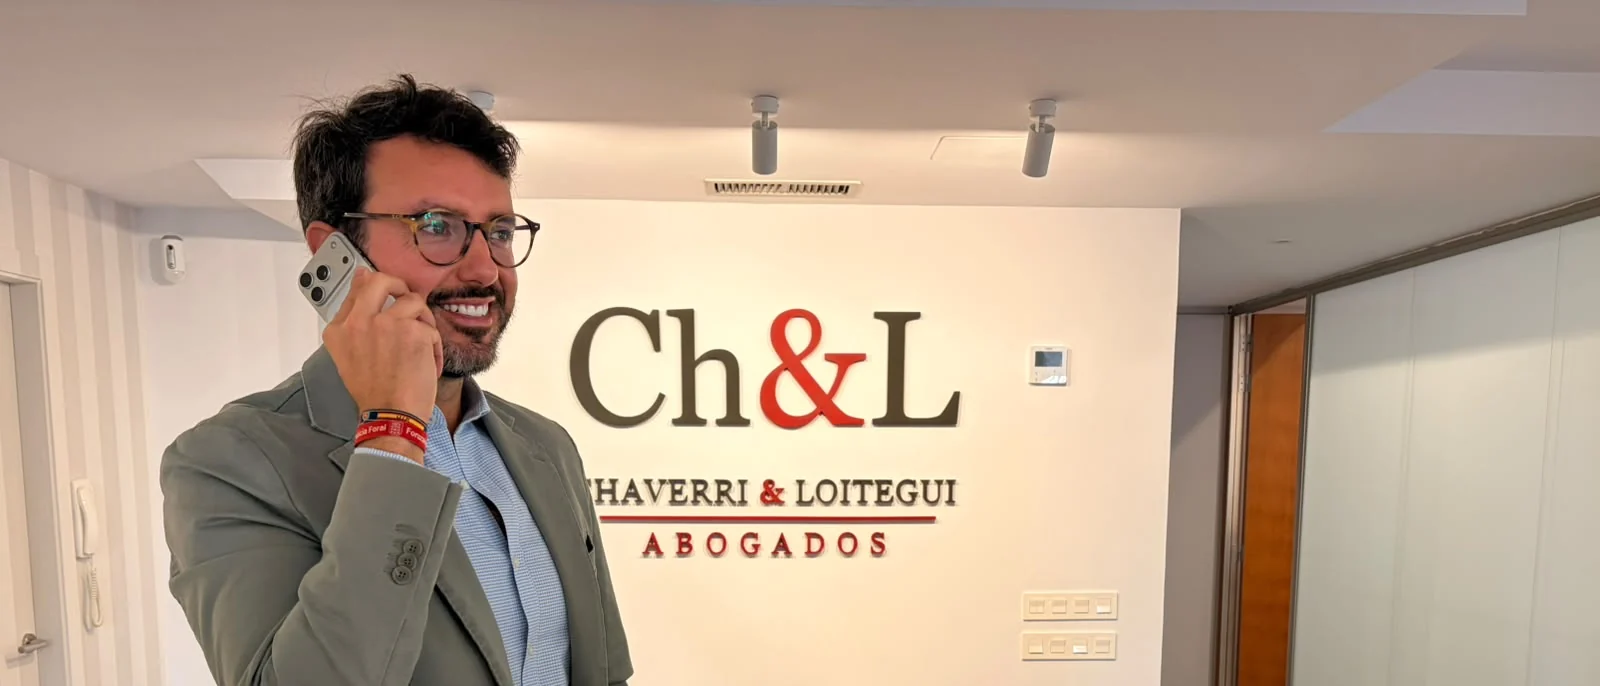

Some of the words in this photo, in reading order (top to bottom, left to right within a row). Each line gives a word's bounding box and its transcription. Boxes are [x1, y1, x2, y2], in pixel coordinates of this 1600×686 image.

[569, 306, 961, 429] Ch&L
[587, 478, 749, 505] HAVERRI
[759, 478, 785, 505] &
[795, 478, 957, 505] LOITEGUI
[641, 531, 887, 557] ABOGADOS
